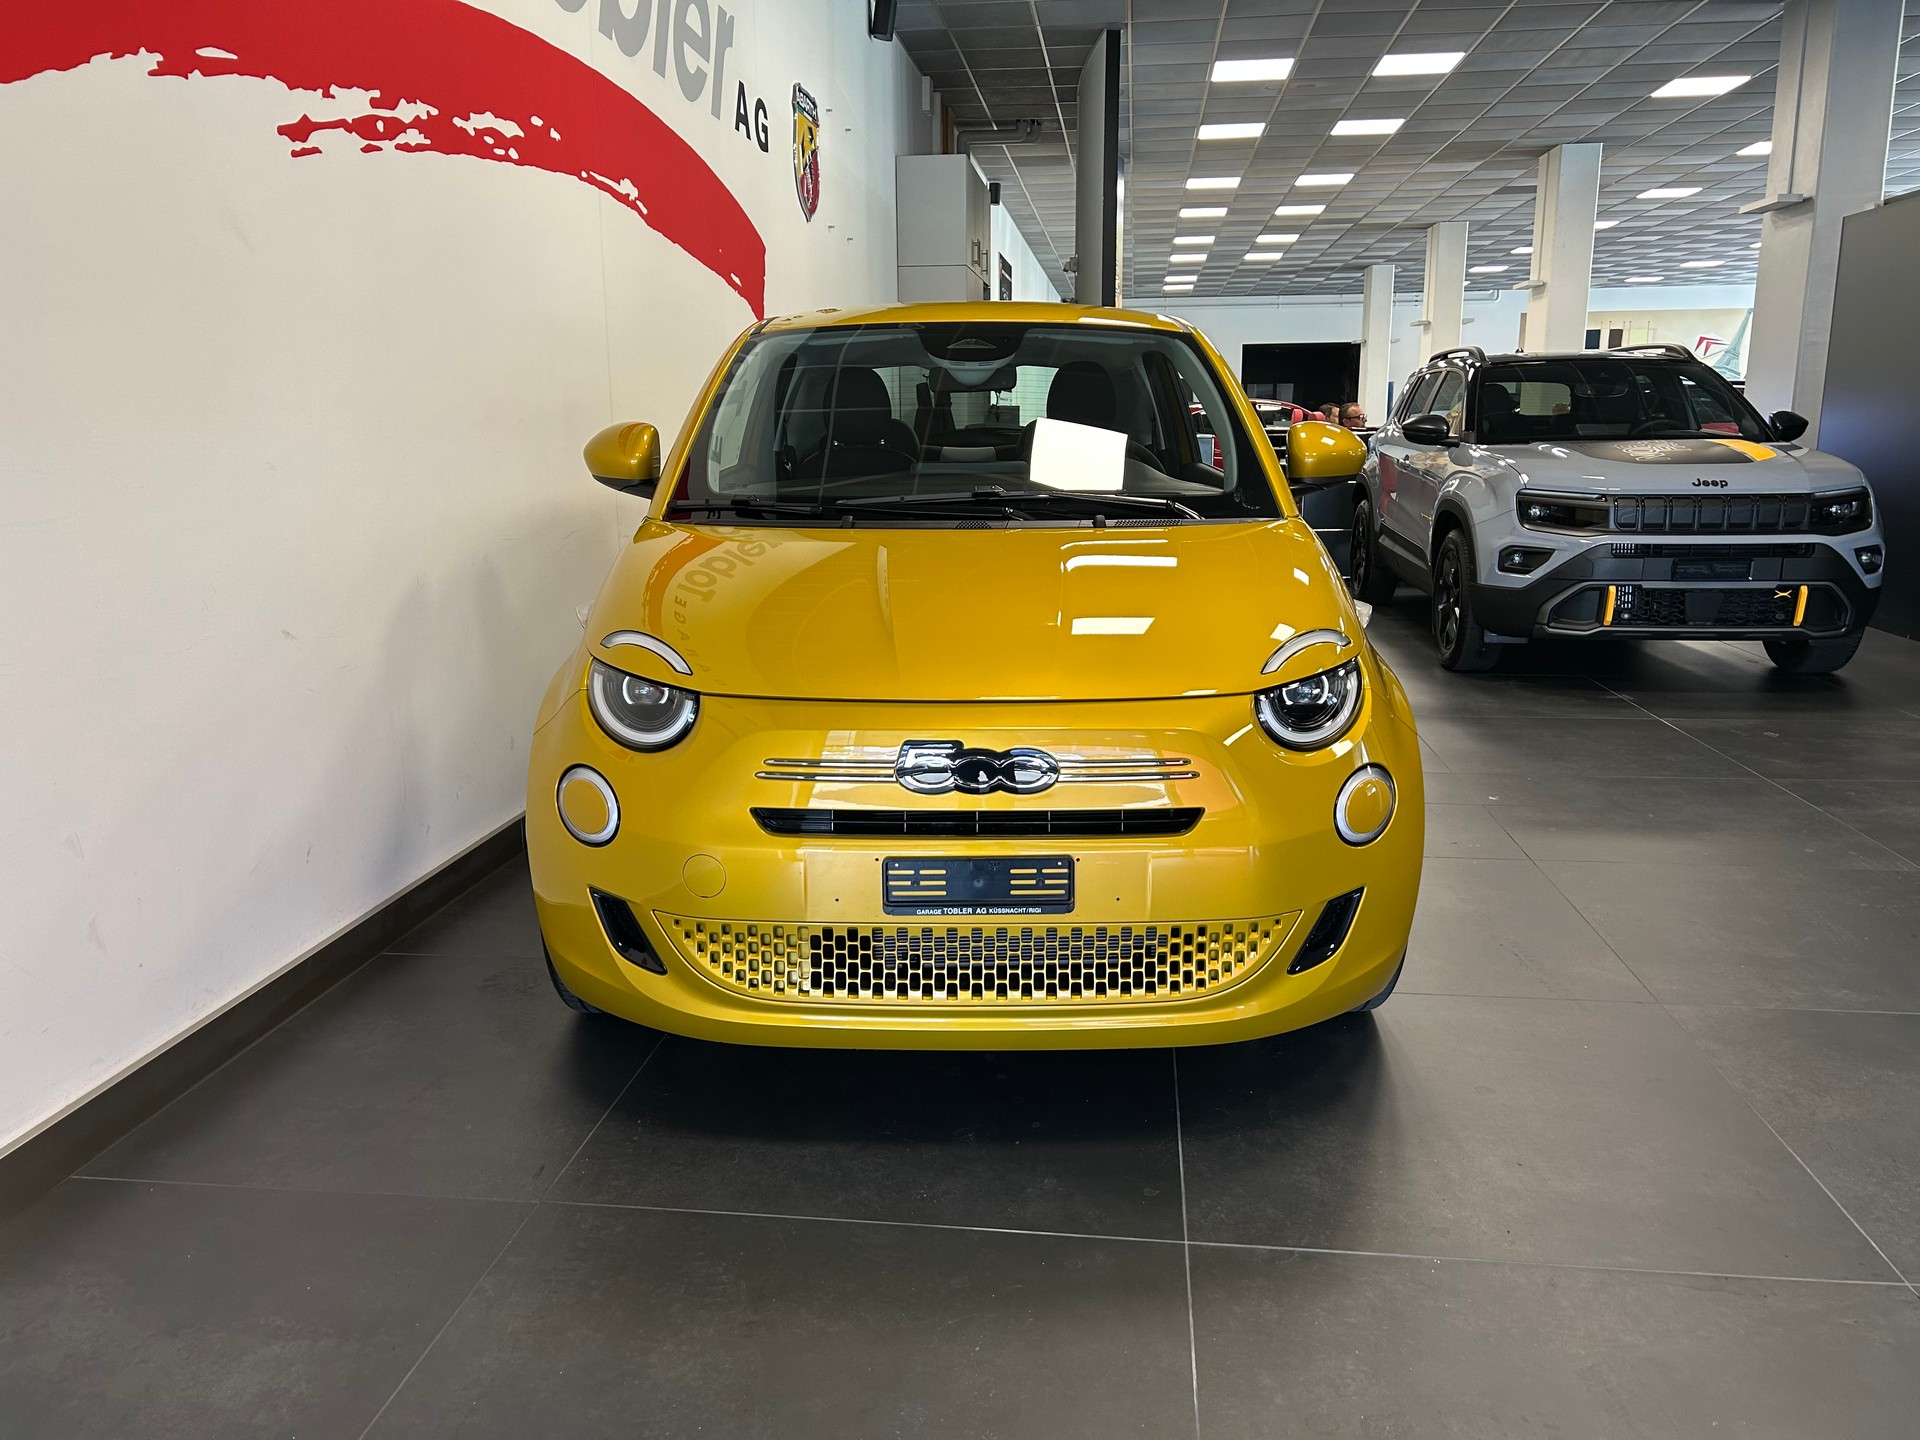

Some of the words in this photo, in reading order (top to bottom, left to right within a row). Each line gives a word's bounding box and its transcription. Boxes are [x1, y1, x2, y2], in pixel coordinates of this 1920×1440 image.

[734, 80, 769, 153] AG
[1692, 478, 1728, 488] Jeep
[895, 739, 1060, 794] 500
[943, 907, 973, 915] TOBLER
